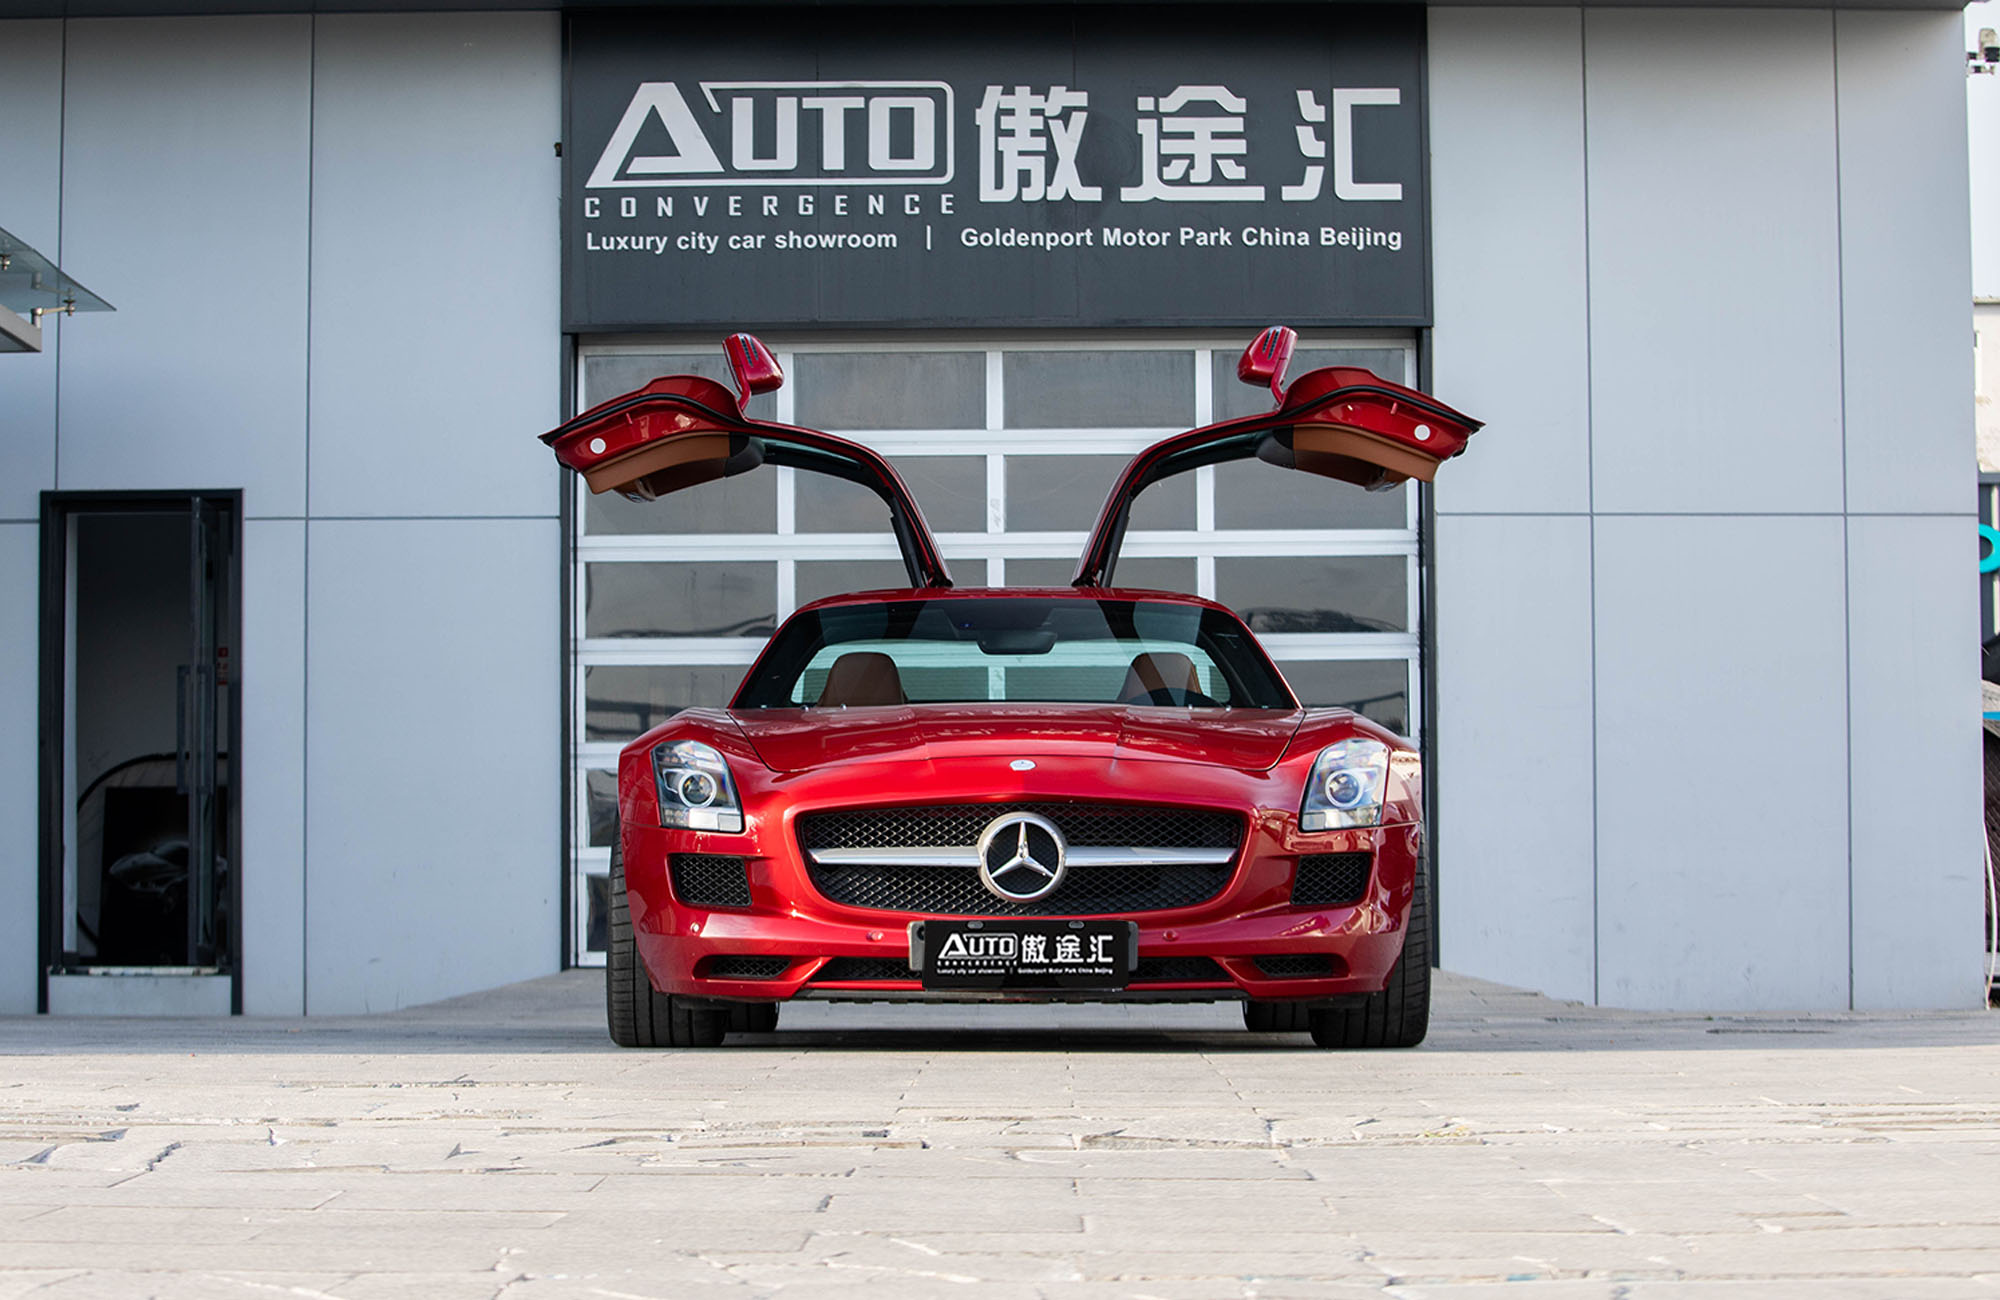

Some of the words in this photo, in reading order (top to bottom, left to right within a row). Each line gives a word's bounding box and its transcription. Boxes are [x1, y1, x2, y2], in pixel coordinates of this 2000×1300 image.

[586, 82, 940, 188] AUTO
[976, 85, 1402, 201] 傲途汇
[585, 193, 954, 218] CONVERGENCE
[587, 231, 668, 255] Luxury
[677, 231, 719, 254] city
[728, 234, 766, 250] car
[774, 230, 897, 250] showroom
[960, 227, 1093, 251] Goldenport
[1102, 227, 1171, 247] Motor
[1179, 227, 1232, 247] Park
[1241, 226, 1310, 247] China
[1320, 226, 1402, 251] Beijing
[938, 933, 1015, 959] AUTO
[1021, 934, 1114, 963] 傲途汇
